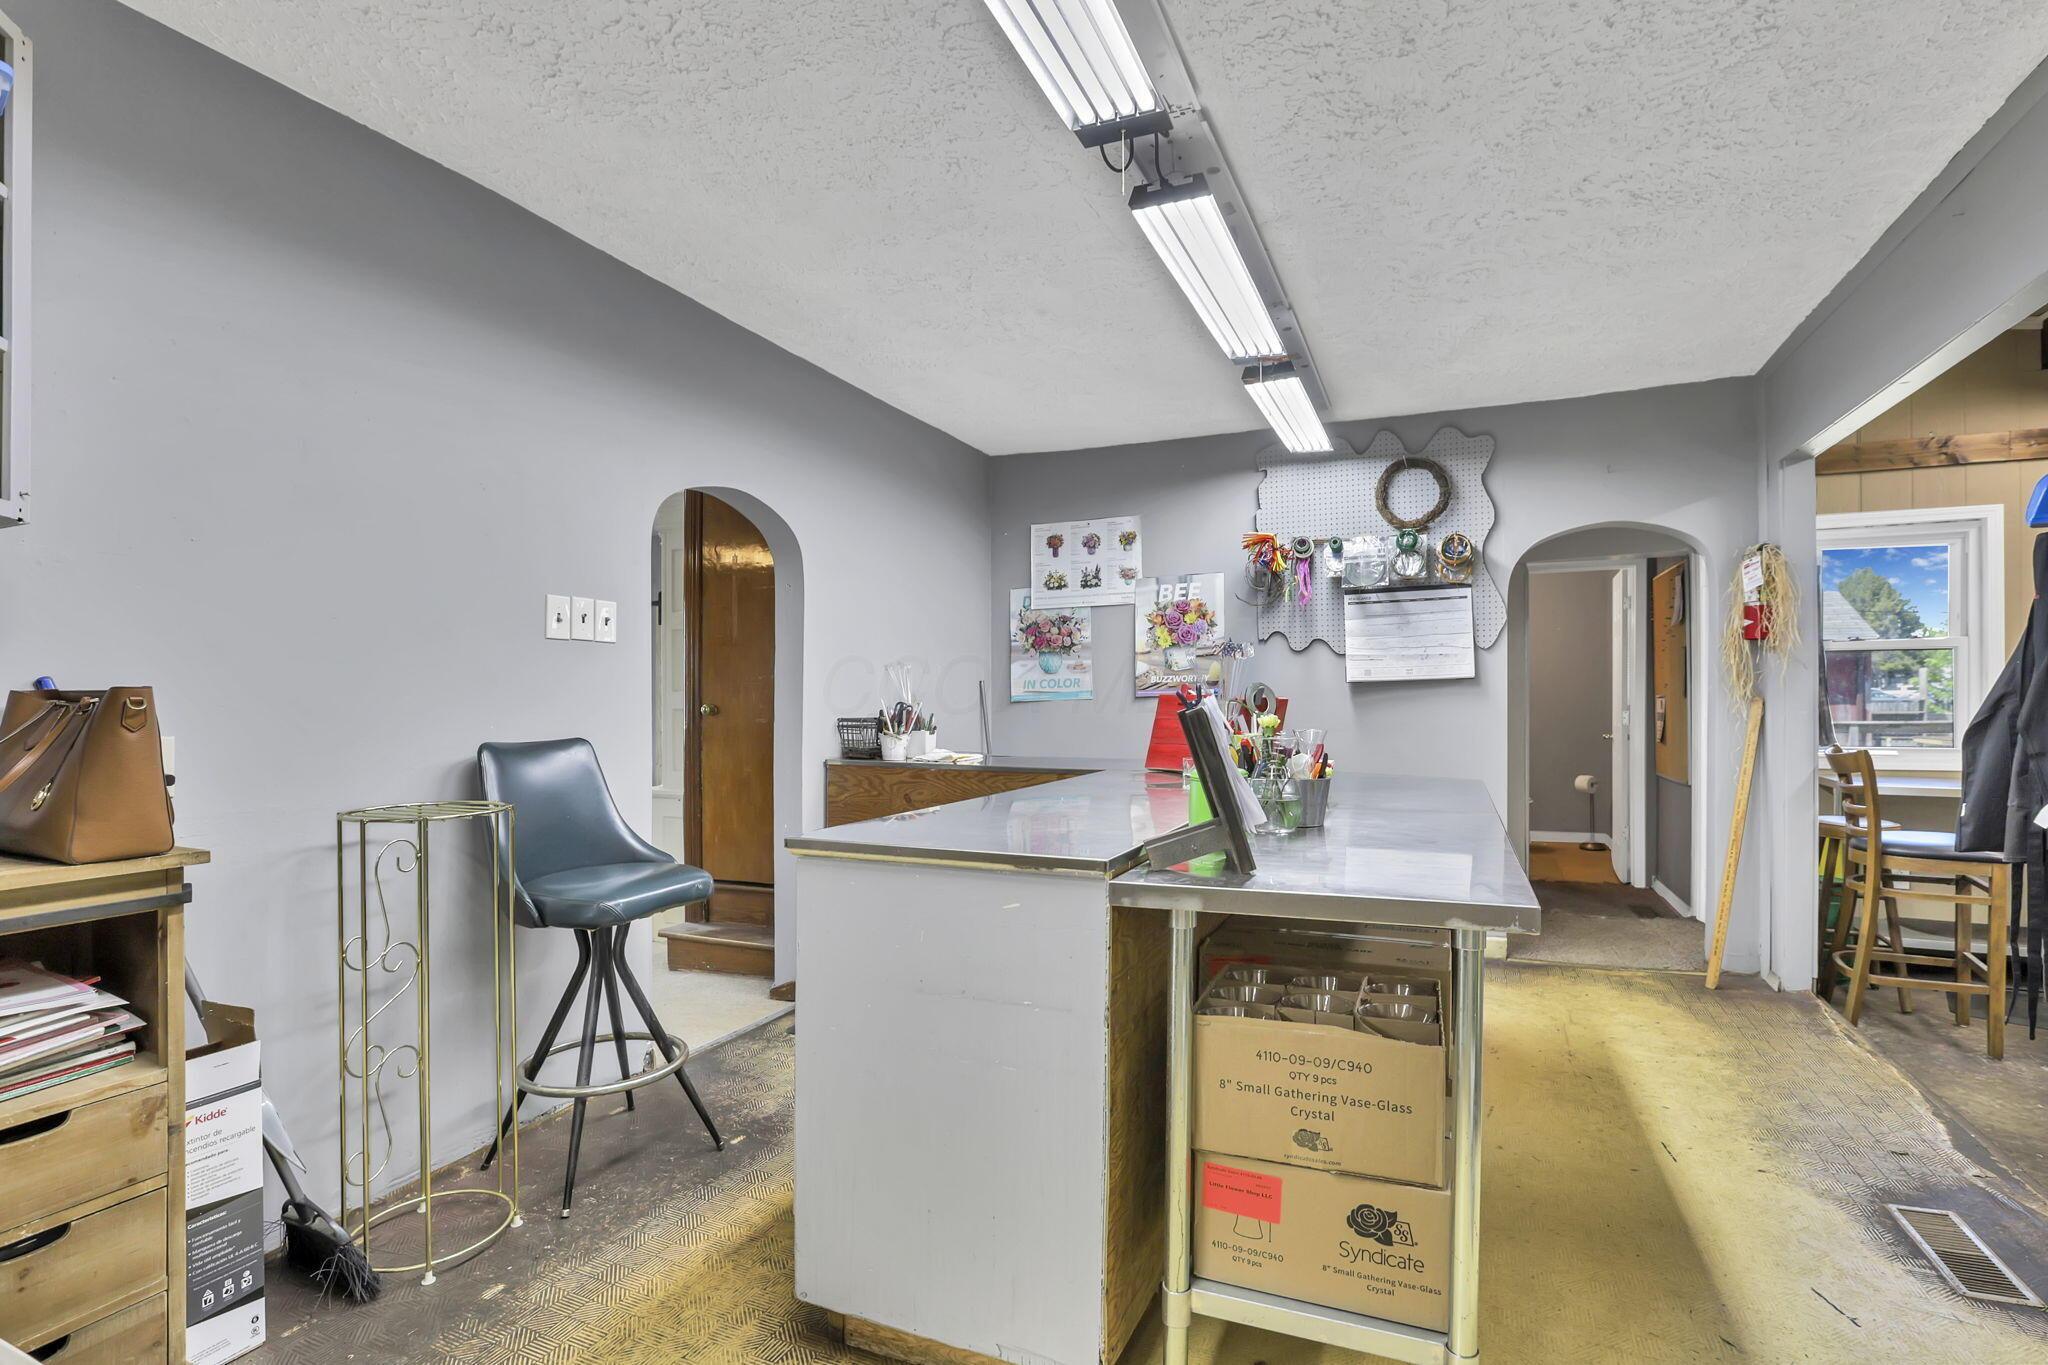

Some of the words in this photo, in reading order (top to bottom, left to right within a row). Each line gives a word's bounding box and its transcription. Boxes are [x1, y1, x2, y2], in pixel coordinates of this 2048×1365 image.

[1159, 582, 1202, 602] BEE
[1024, 680, 1036, 690] IN
[1040, 678, 1080, 689] COLOR
[1256, 1050, 1372, 1074] 4110-09-09/C940
[1289, 1071, 1310, 1082] QTY
[1312, 1074, 1318, 1083] 9
[1320, 1076, 1337, 1085] pcs
[1219, 1079, 1232, 1089] 8"
[1236, 1081, 1270, 1096] Small
[1274, 1086, 1337, 1106] Gathering
[1340, 1096, 1413, 1114] Vase-Glass
[195, 1109, 226, 1124] Kidde
[1290, 1106, 1335, 1122] Crystal
[186, 1132, 210, 1145] xtintor
[186, 1140, 217, 1154] cendios
[220, 1126, 256, 1143] recargable
[1212, 1240, 1284, 1262] 4110-09-09/C940
[1232, 1255, 1245, 1263] QTY
[1340, 1241, 1424, 1273] Syndicate
[1333, 1268, 1355, 1277] Small
[1357, 1272, 1396, 1287] Gathering
[1398, 1280, 1442, 1296] Vase-Glass
[1366, 1284, 1394, 1296] Crystal
